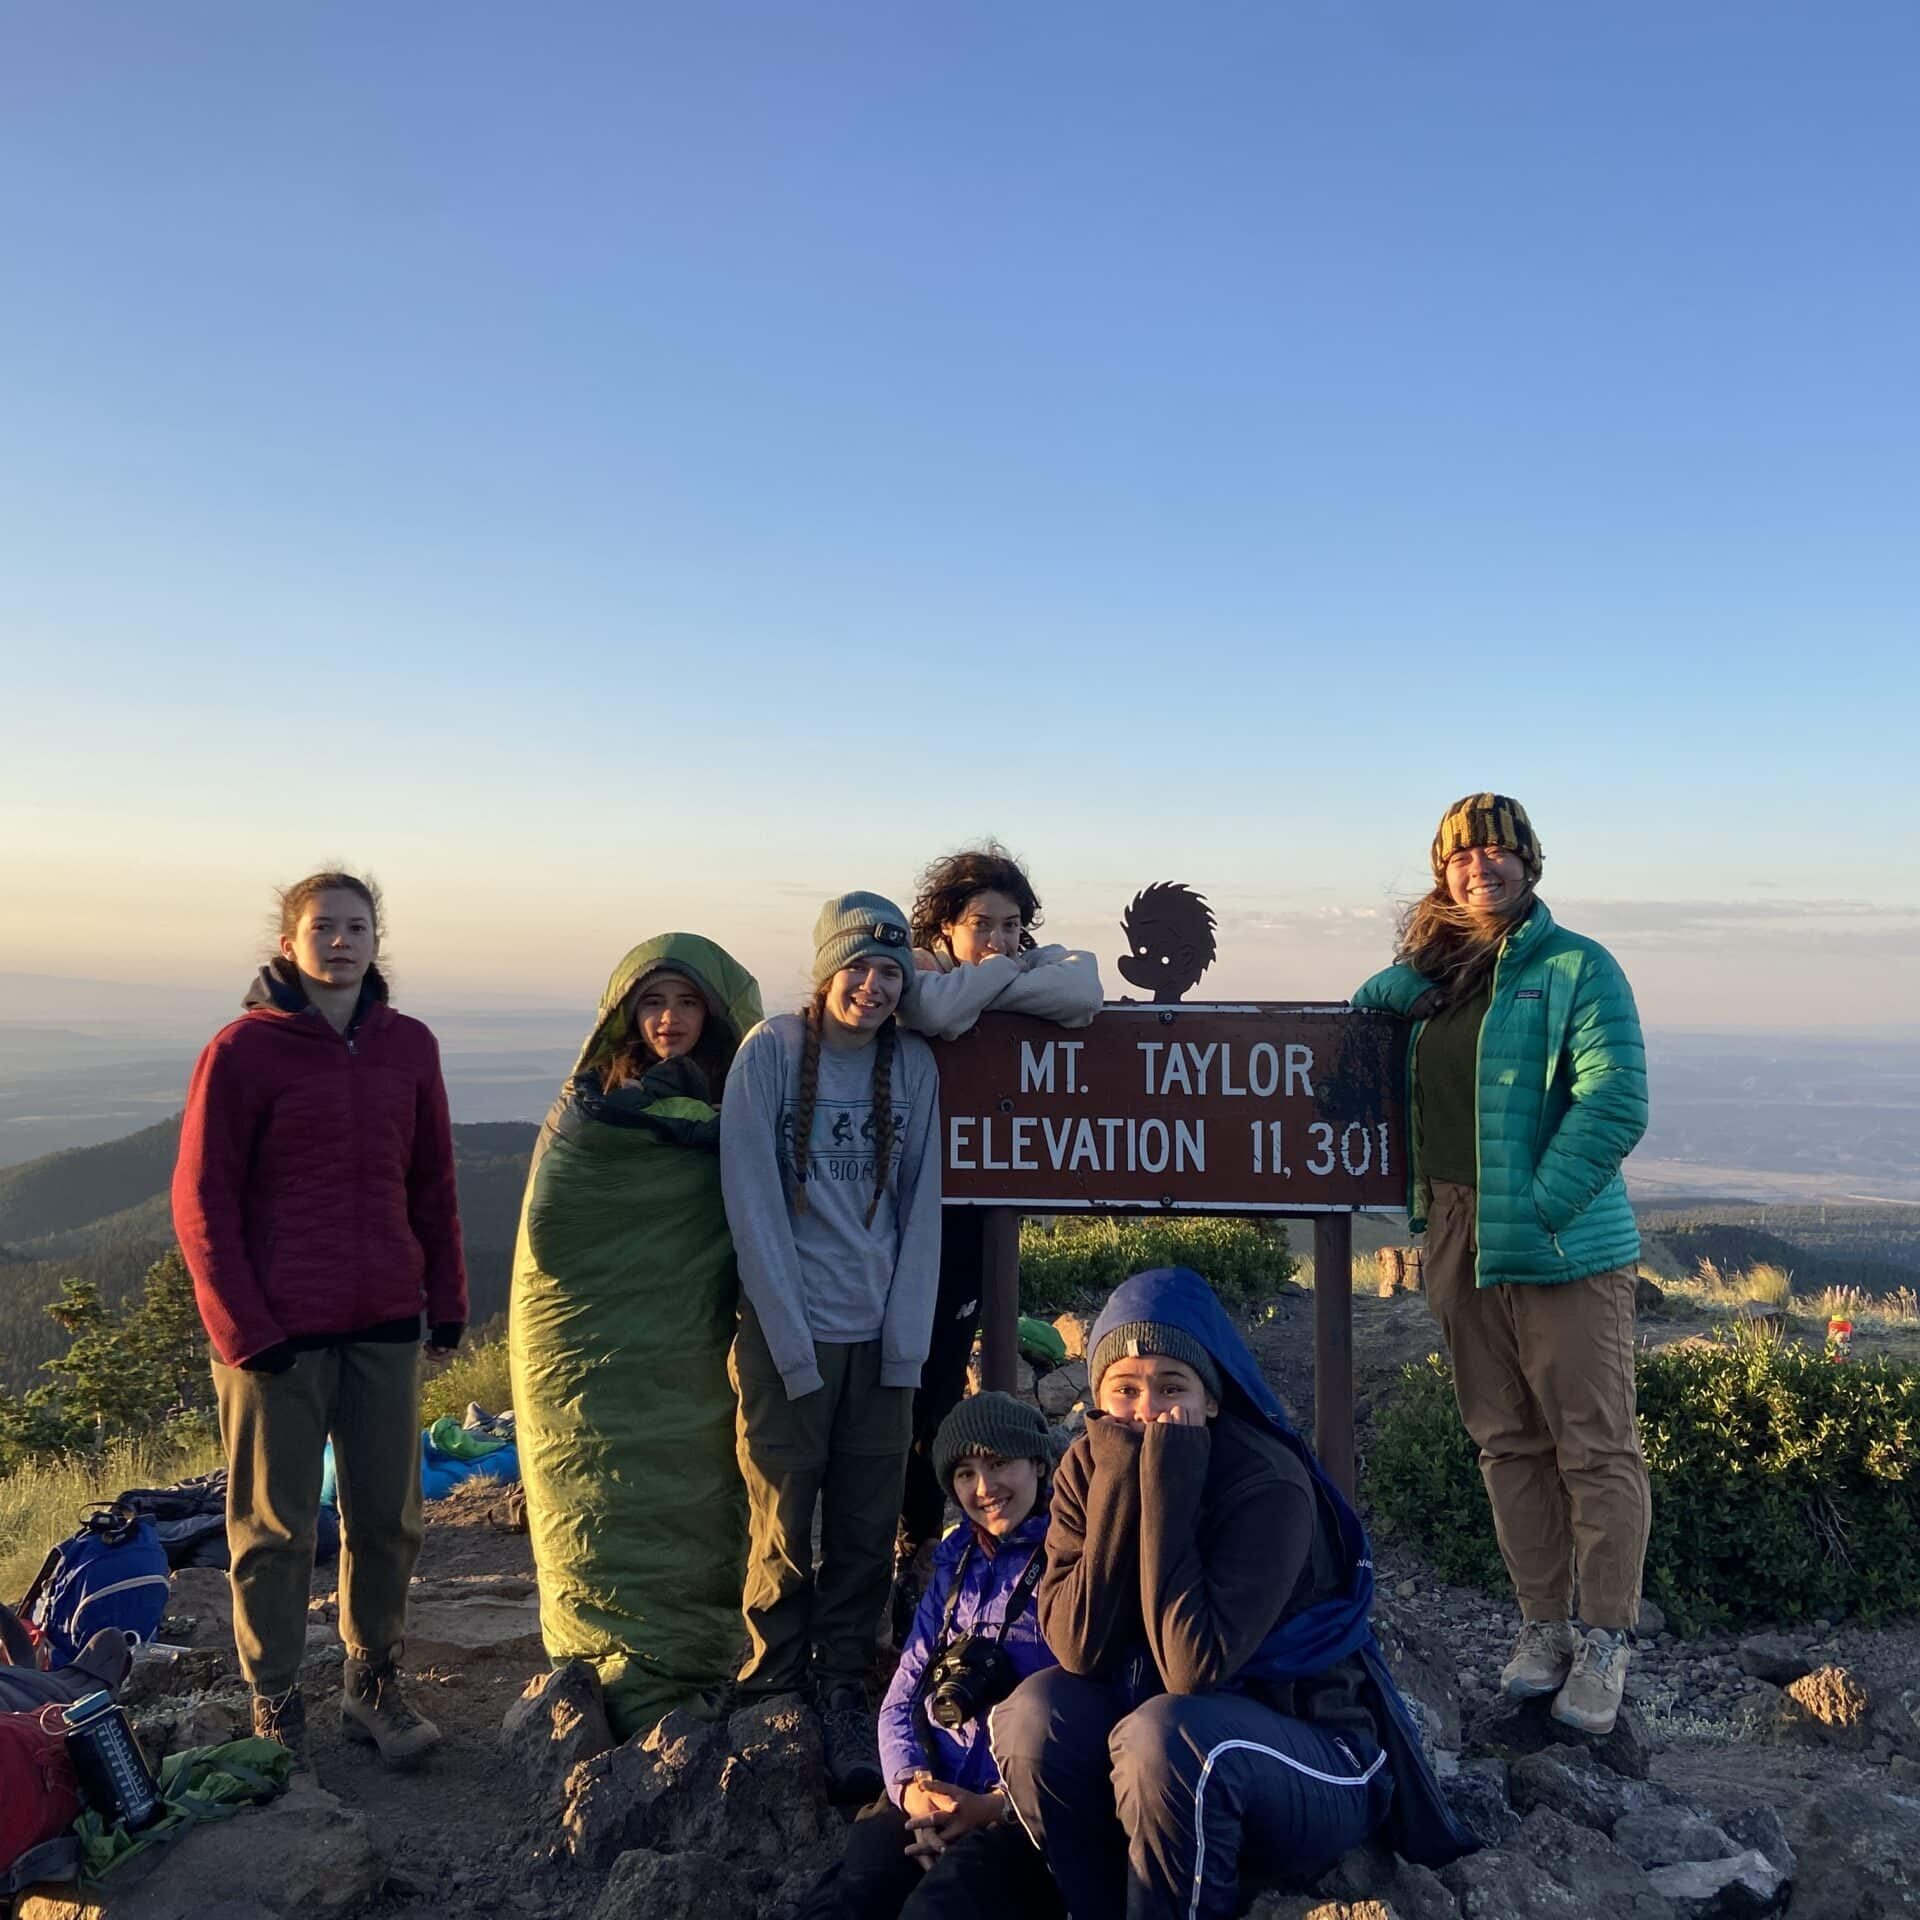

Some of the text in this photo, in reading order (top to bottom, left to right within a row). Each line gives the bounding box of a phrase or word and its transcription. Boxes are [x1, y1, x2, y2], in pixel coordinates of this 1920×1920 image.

[1020, 1041, 1315, 1097] MT. TAYLOR
[949, 1117, 1206, 1173] ELEVATION
[1024, 1562, 1041, 1586] EOS
